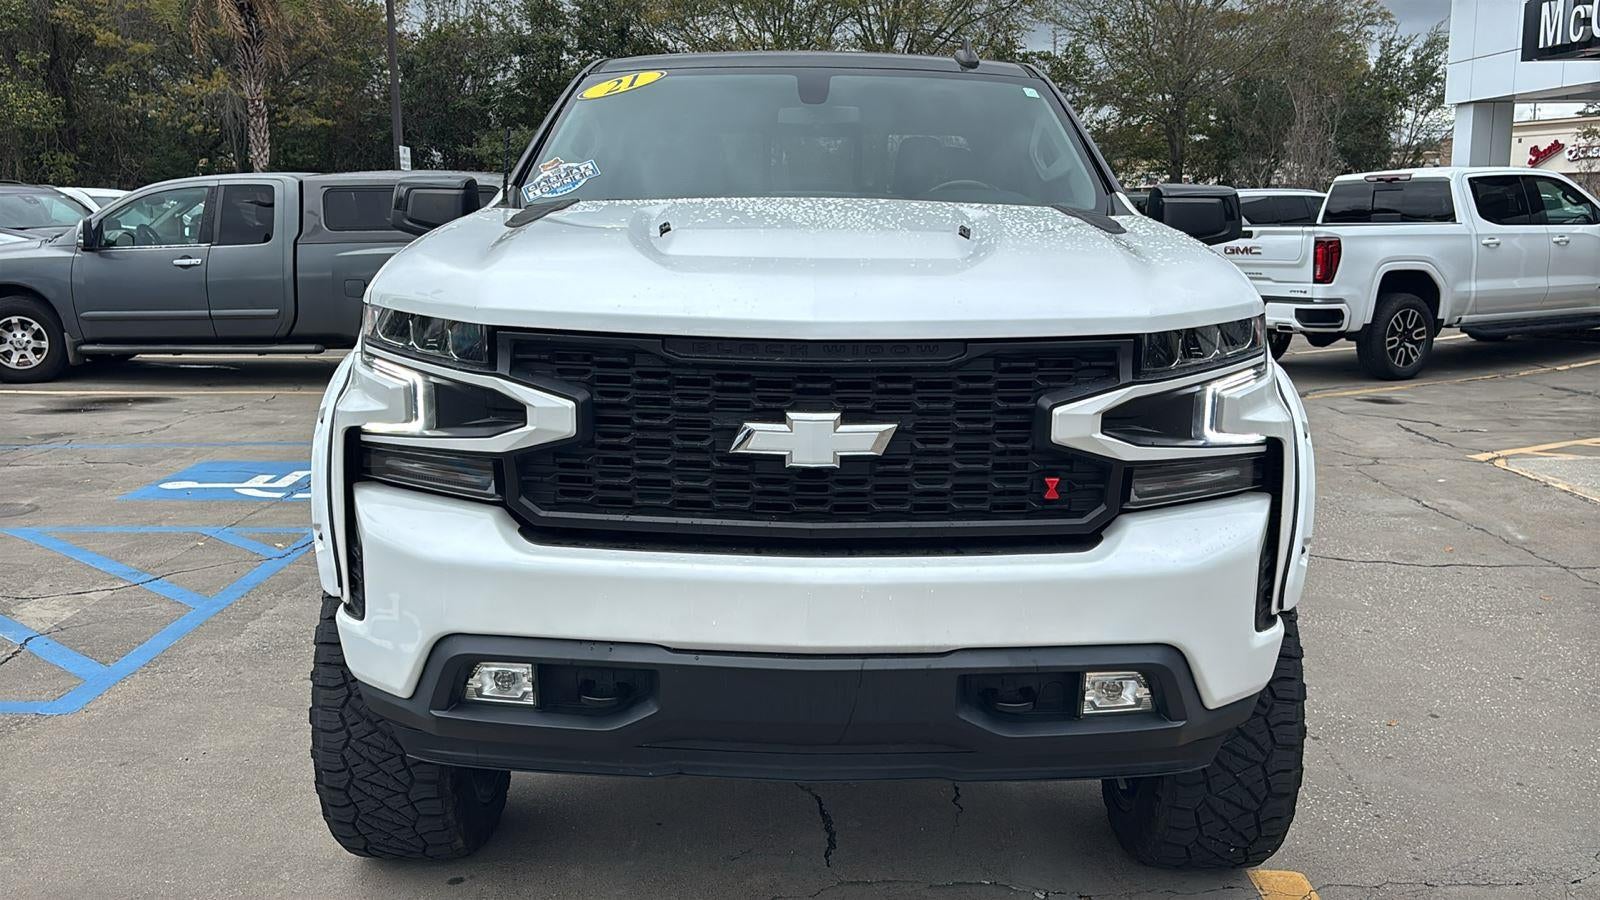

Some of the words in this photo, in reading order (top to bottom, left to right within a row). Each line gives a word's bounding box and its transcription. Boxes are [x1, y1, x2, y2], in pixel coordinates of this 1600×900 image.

[604, 72, 640, 95] 21
[528, 164, 591, 193] CARFAX
[541, 169, 593, 193] OWNER
[1224, 246, 1263, 256] GMC
[692, 342, 809, 358] BLACK
[822, 343, 940, 356] WIDOW
